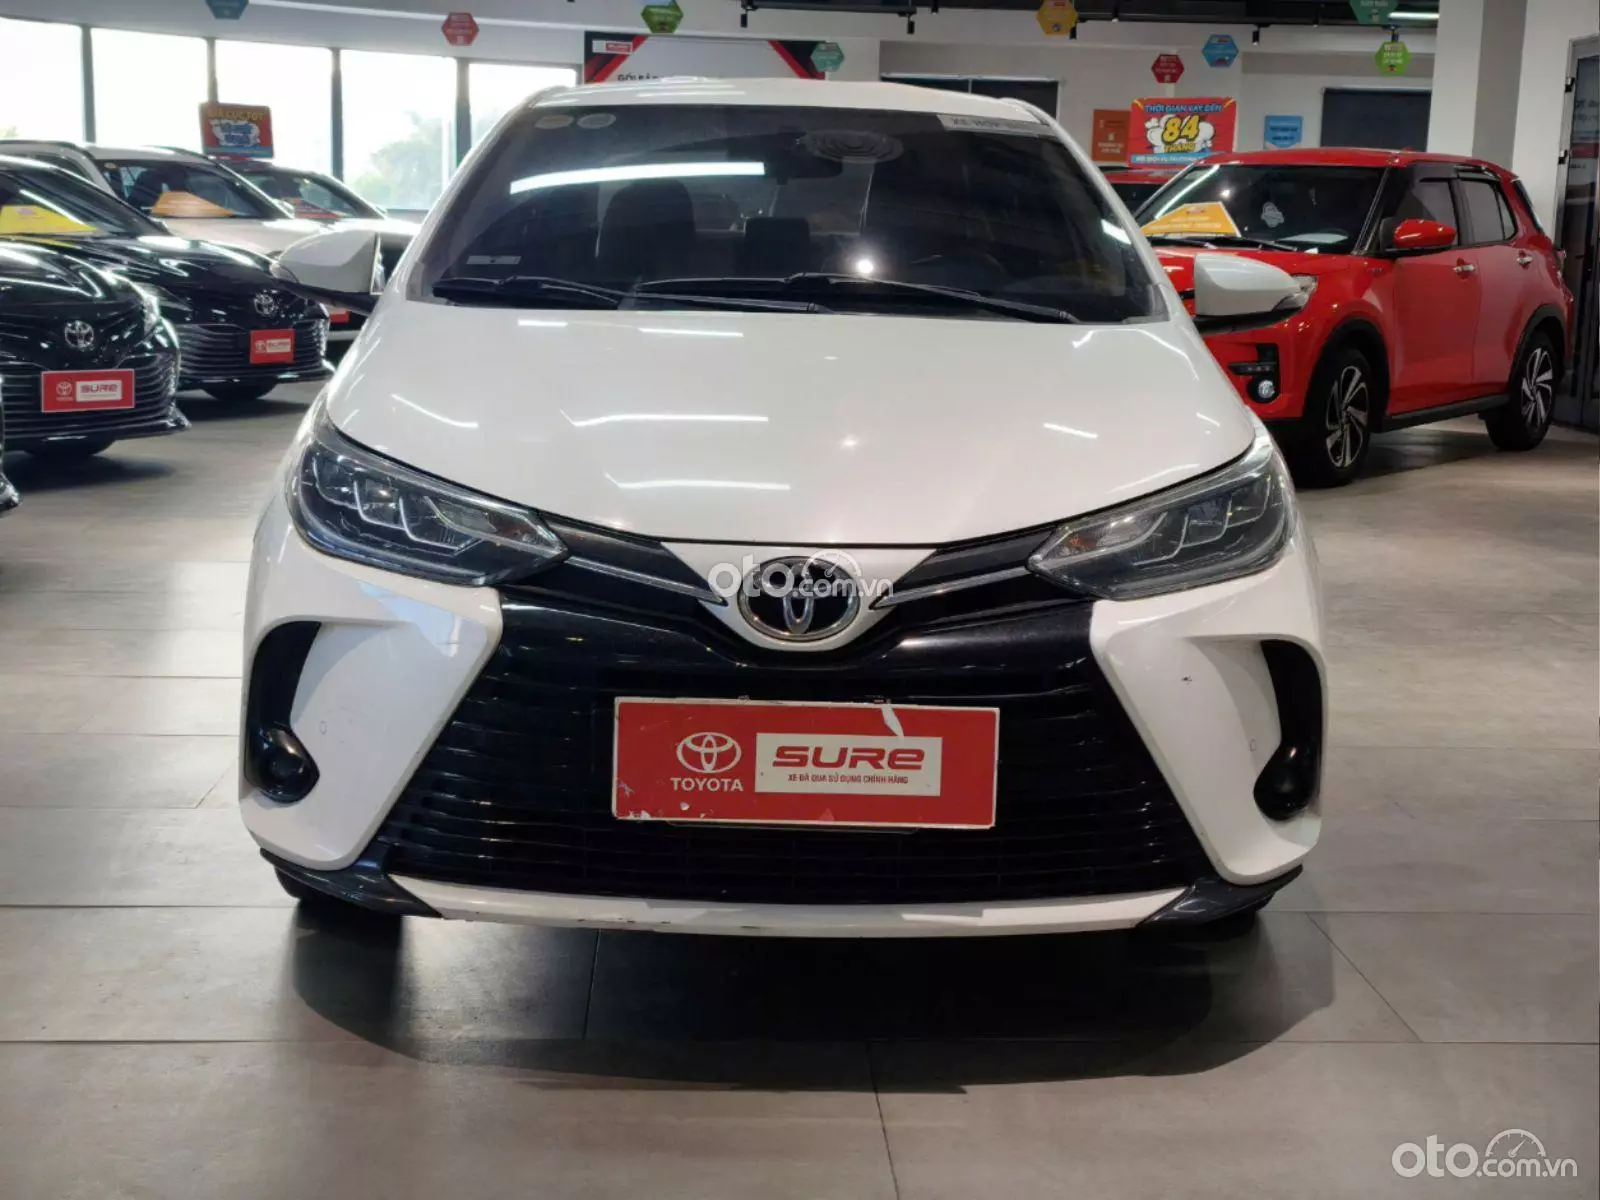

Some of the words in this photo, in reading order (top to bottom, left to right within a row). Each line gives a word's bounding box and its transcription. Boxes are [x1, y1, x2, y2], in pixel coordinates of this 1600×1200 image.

[1165, 104, 1187, 113] GIAN
[1161, 113, 1200, 144] 84
[788, 773, 798, 782] XE
[811, 773, 827, 783] QUA
[670, 777, 744, 793] TOYOTA
